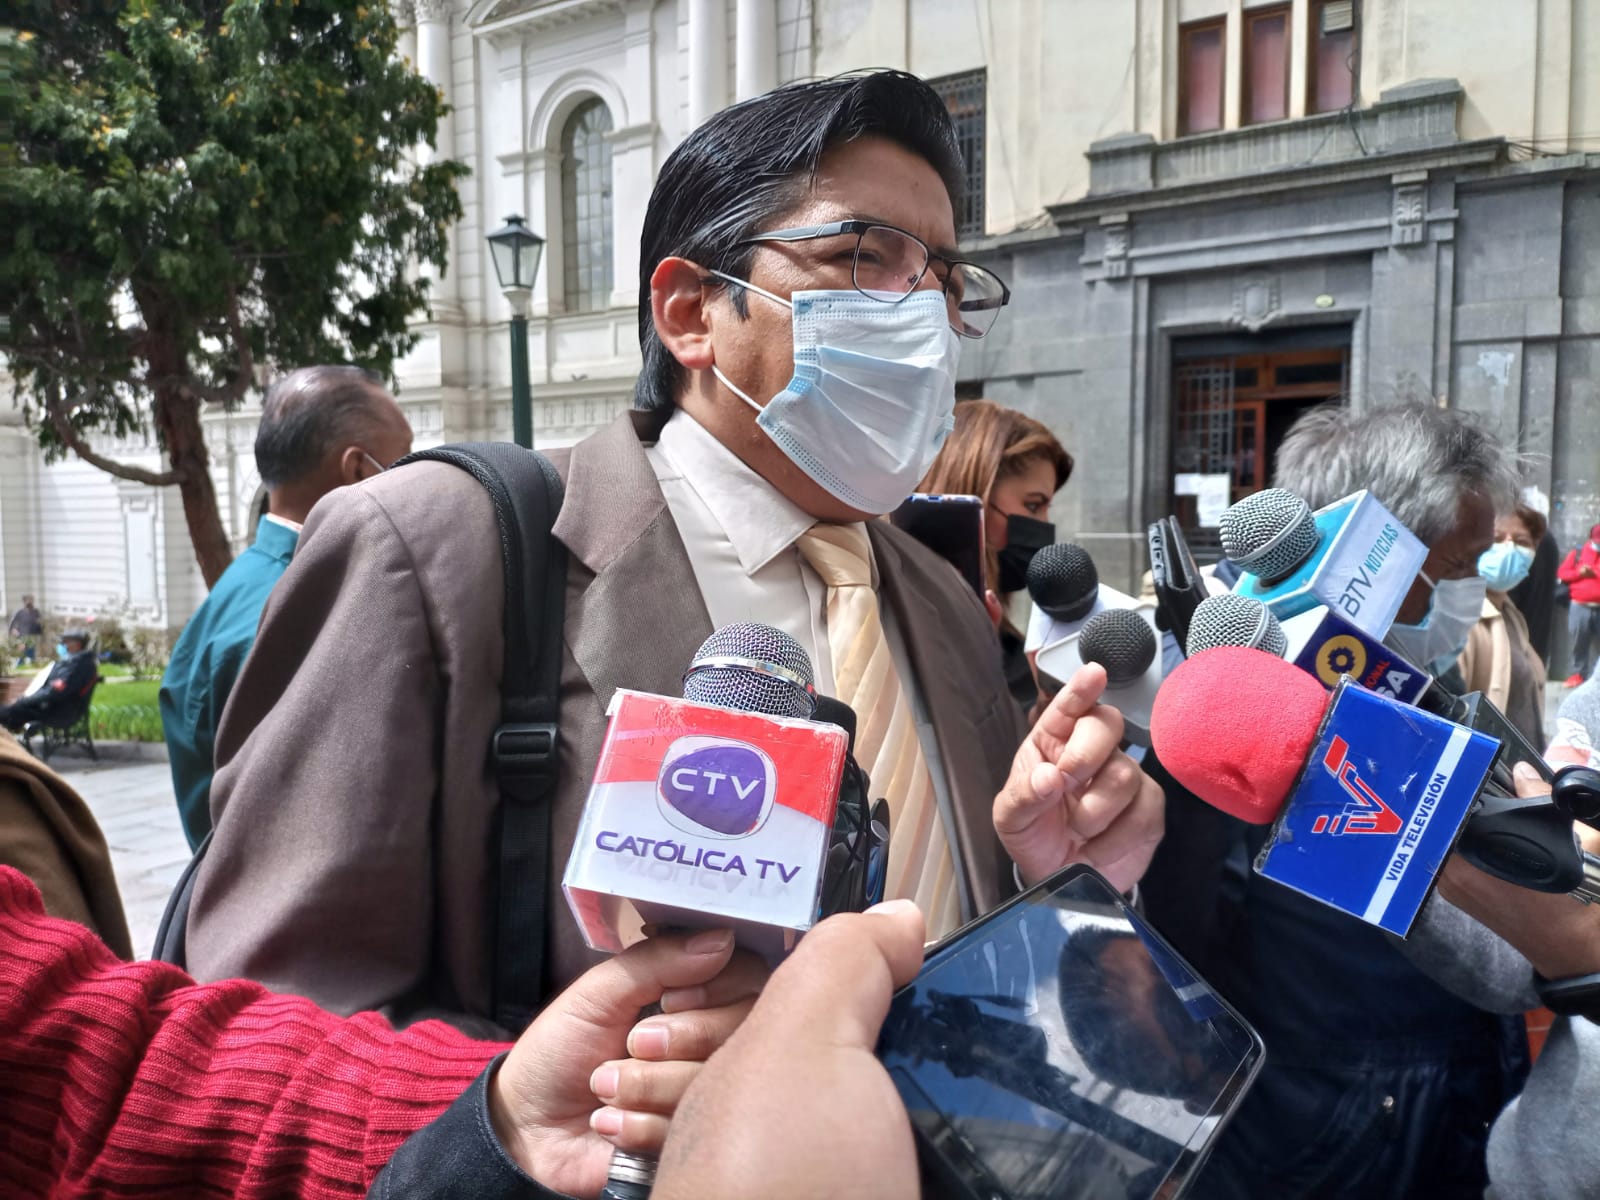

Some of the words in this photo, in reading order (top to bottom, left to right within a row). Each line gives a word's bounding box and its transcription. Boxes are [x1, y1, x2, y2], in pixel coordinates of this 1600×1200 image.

[1338, 566, 1372, 618] BTV
[1363, 523, 1399, 575] NOTICIAS
[671, 767, 764, 801] CTV
[595, 830, 748, 877] CATÓLICA
[755, 858, 802, 884] TV
[1385, 852, 1410, 882] VIDA
[1402, 773, 1448, 851] TELEVISIÓN
